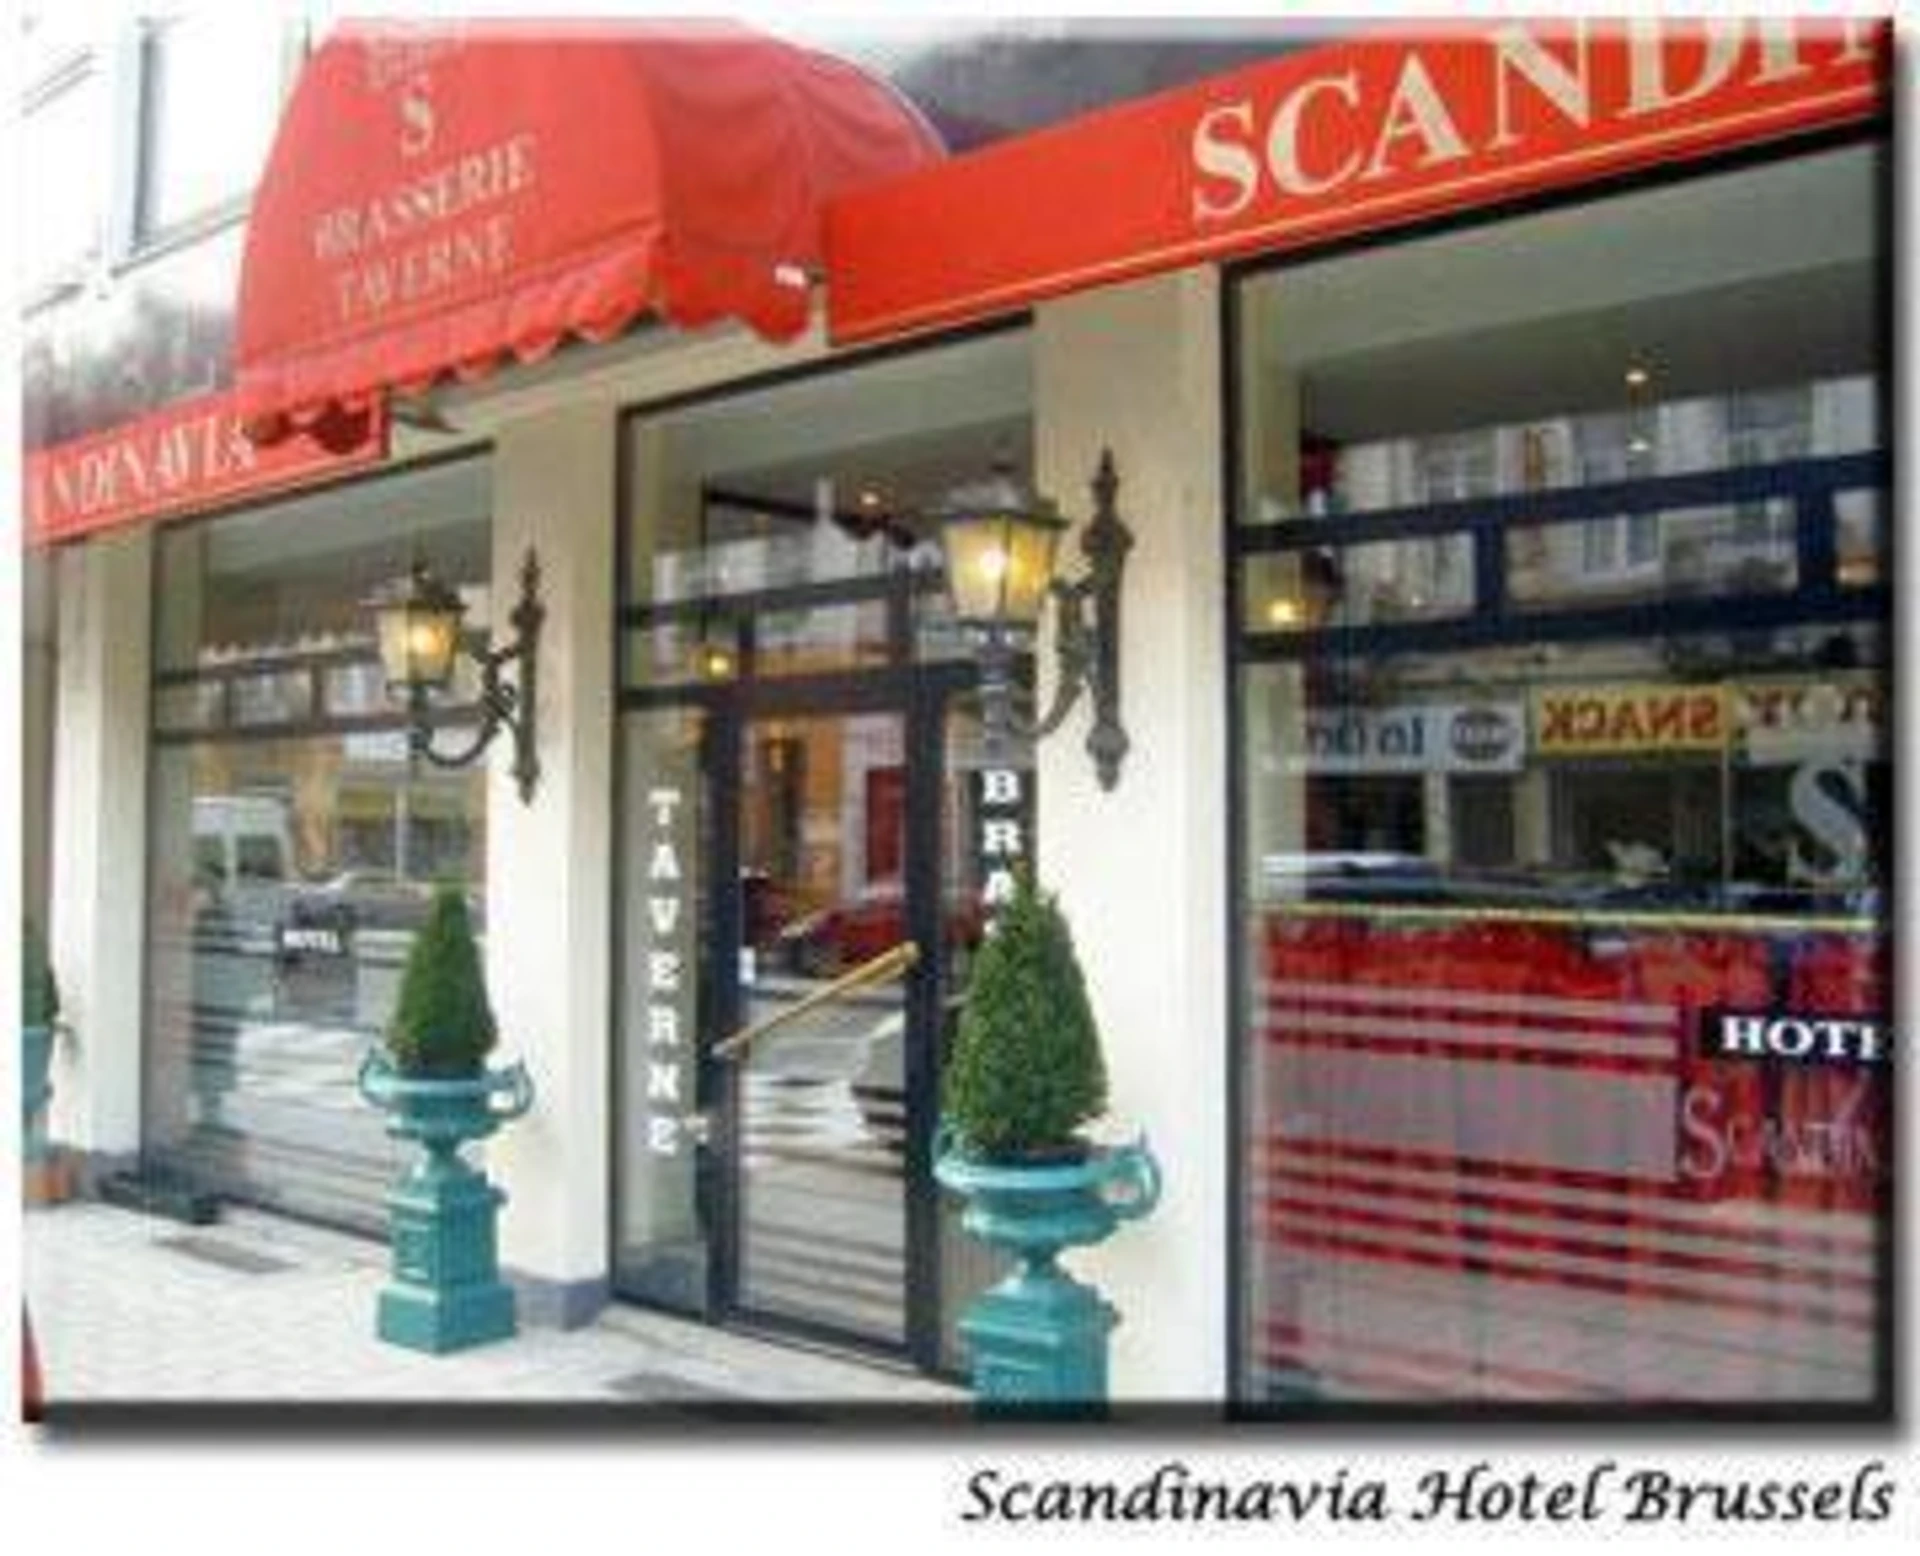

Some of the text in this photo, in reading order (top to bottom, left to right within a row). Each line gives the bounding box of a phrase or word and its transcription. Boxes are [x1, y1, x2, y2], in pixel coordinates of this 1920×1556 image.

[315, 134, 537, 262] BRASSERIE
[338, 218, 517, 320] TAVERNE
[982, 769, 1023, 940] BRA
[646, 788, 683, 1155] TAVERNE
